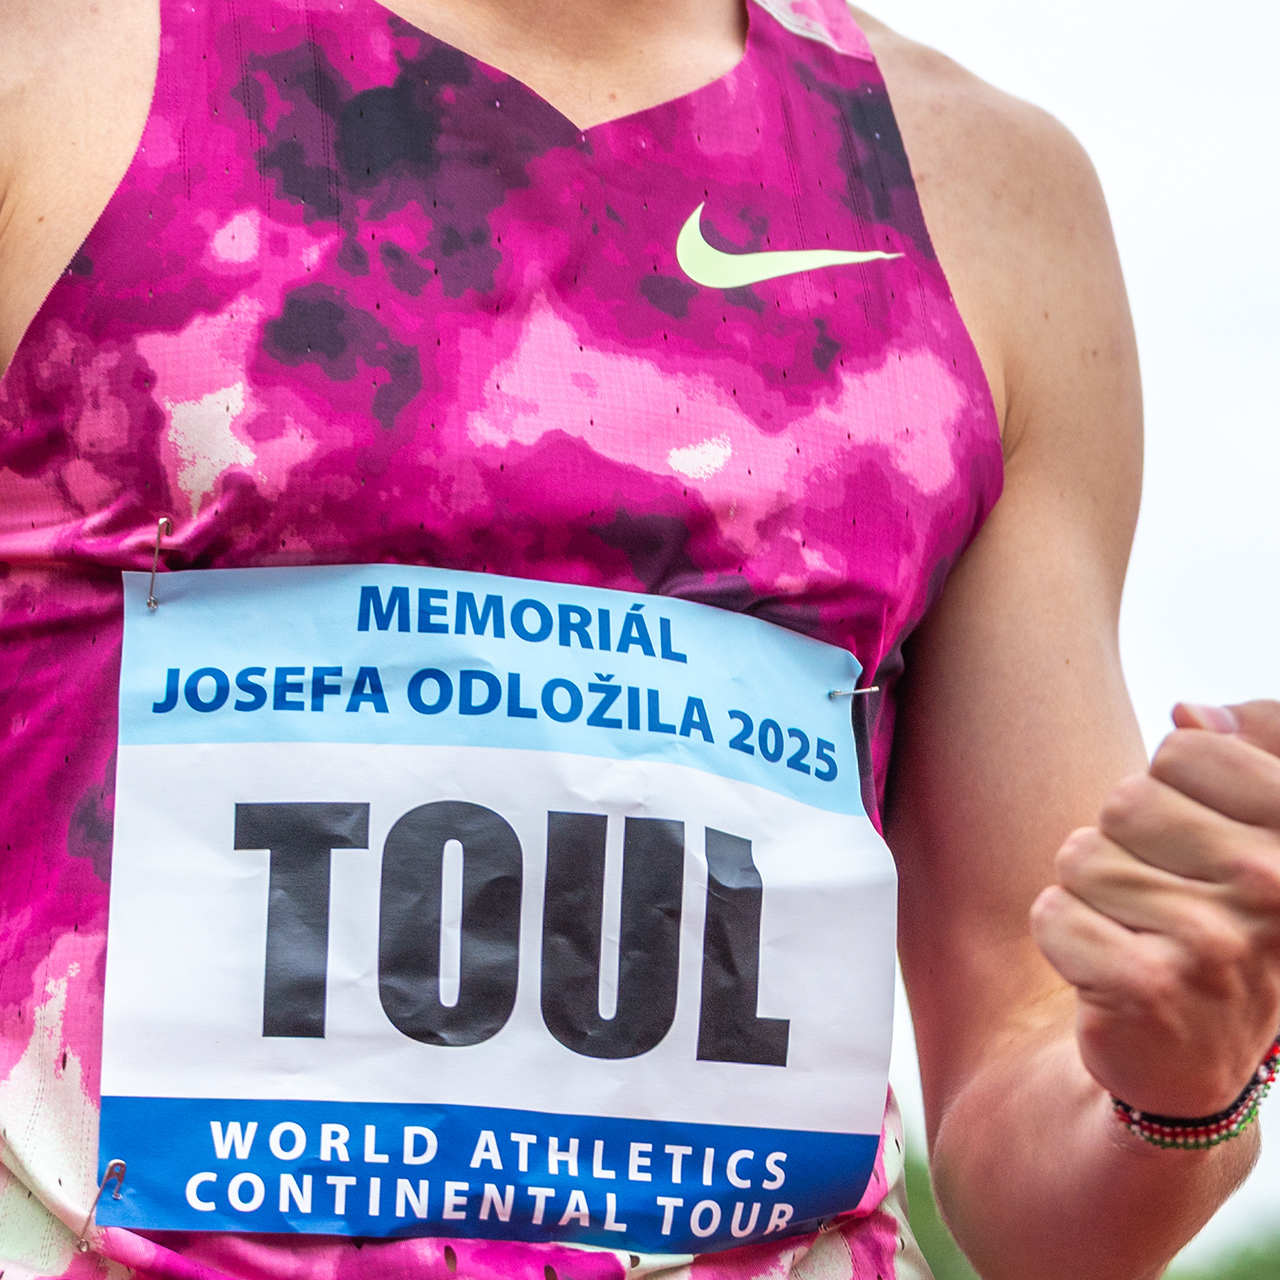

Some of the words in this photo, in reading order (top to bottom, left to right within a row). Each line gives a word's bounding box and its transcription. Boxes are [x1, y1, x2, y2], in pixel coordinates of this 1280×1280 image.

[357, 585, 688, 664] MEMORIÁL
[152, 666, 390, 714] JOSEFA
[406, 668, 715, 746] ODLOŽILA
[727, 709, 840, 783] 2025
[233, 799, 791, 1067] TOUL
[209, 1120, 439, 1166] WORLD
[469, 1129, 789, 1190] ATHLETICS
[184, 1171, 628, 1232] CONTINENTAL
[655, 1195, 794, 1238] TOUR
